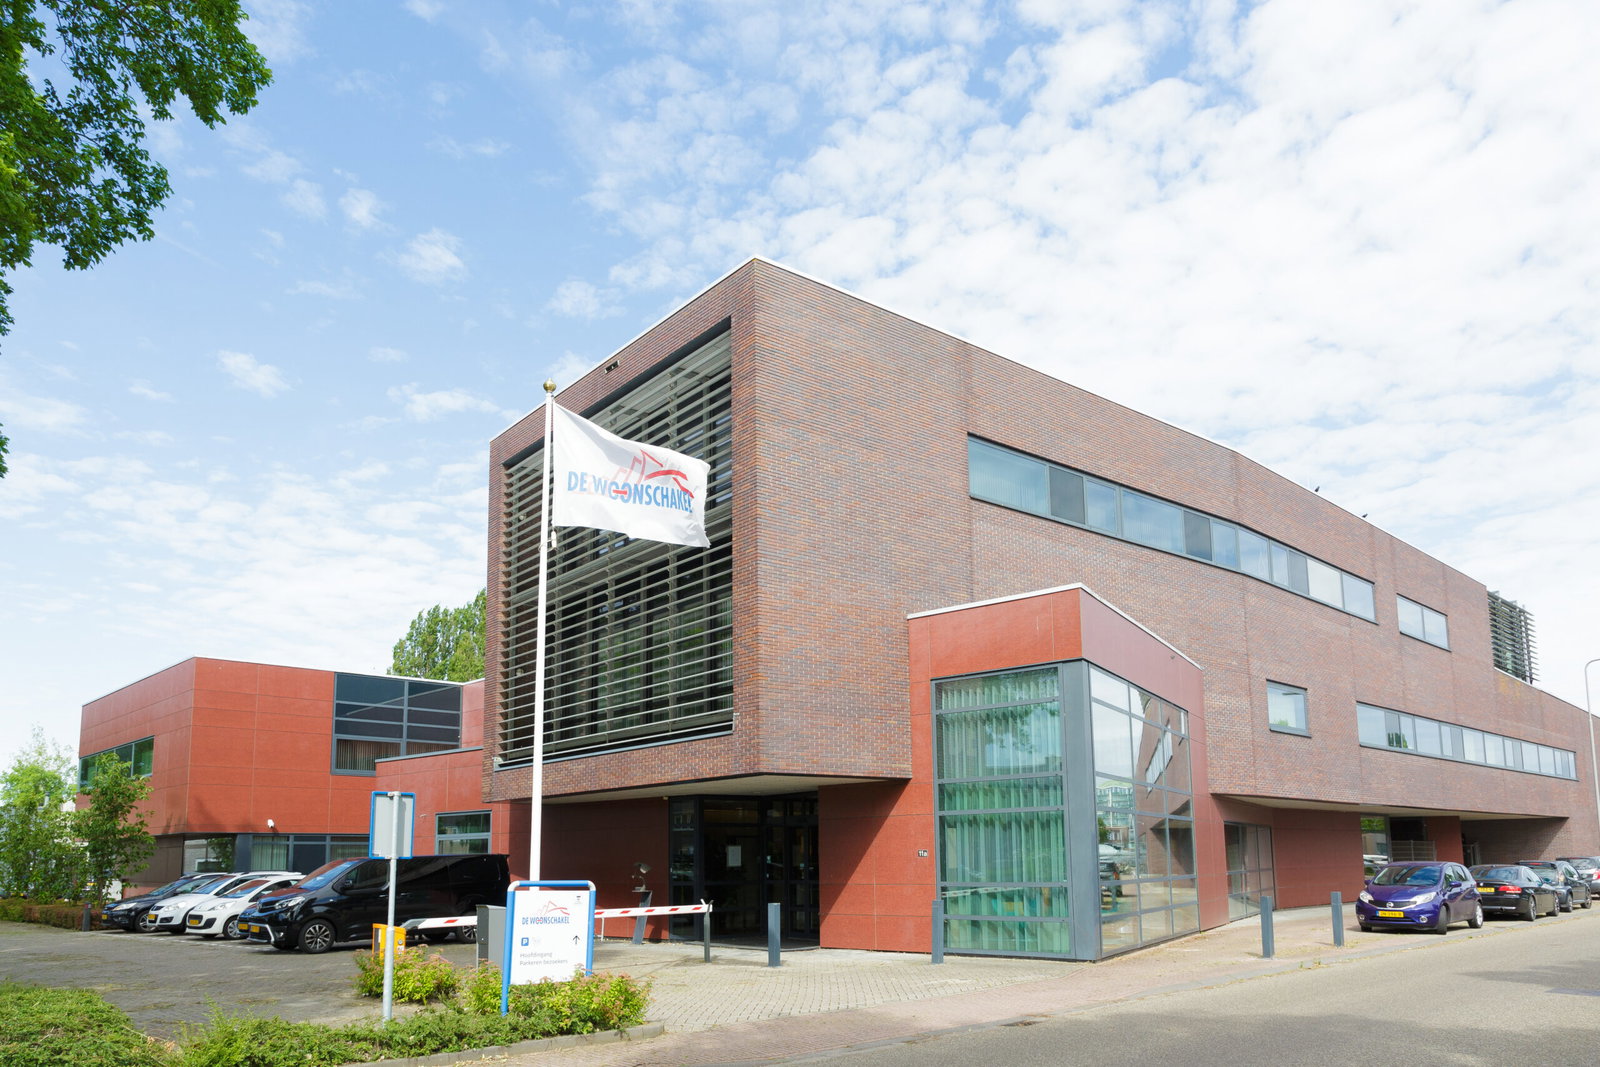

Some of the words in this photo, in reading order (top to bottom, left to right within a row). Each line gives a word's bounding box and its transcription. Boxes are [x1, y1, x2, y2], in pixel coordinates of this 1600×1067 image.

[567, 471, 588, 492] DE
[592, 475, 693, 513] WOONSCHAKEL
[521, 917, 529, 925] DE
[529, 916, 570, 925] WOONSCHAKEL
